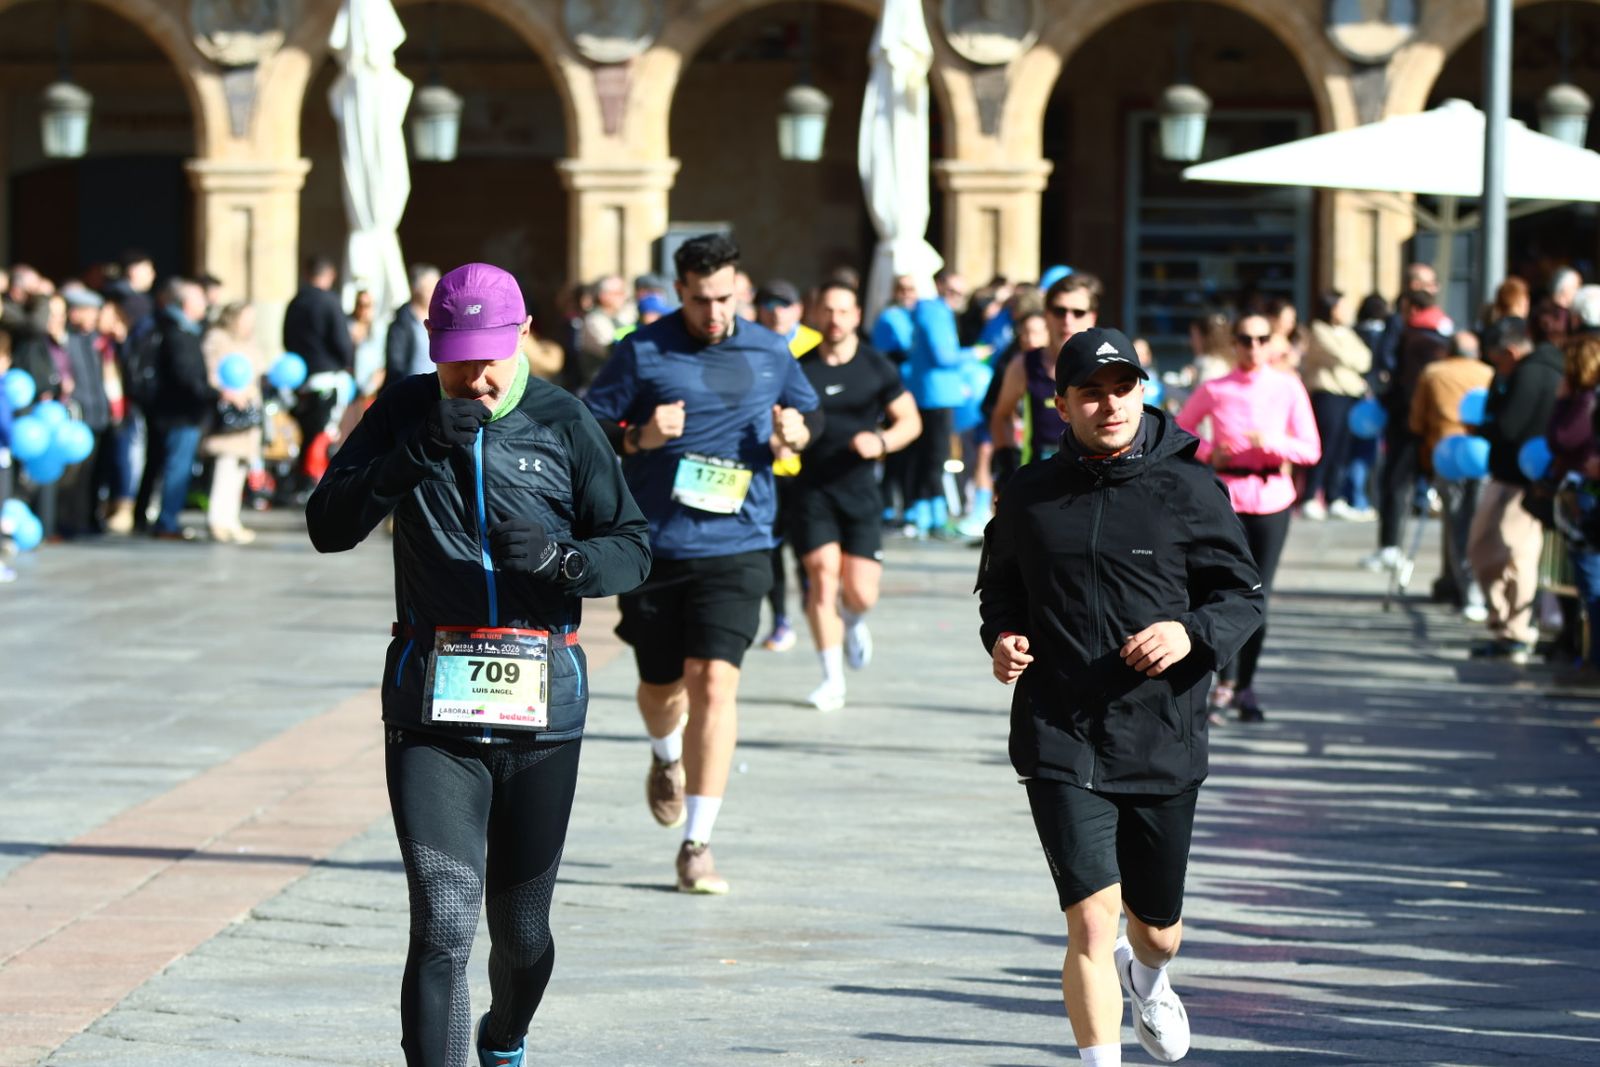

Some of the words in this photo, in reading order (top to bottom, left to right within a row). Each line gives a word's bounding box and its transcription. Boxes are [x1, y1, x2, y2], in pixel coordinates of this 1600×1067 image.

[697, 467, 736, 487] 1728
[442, 644, 456, 653] XIV
[500, 643, 520, 653] 2026
[467, 660, 521, 684] 709
[489, 688, 514, 696] ANGEL
